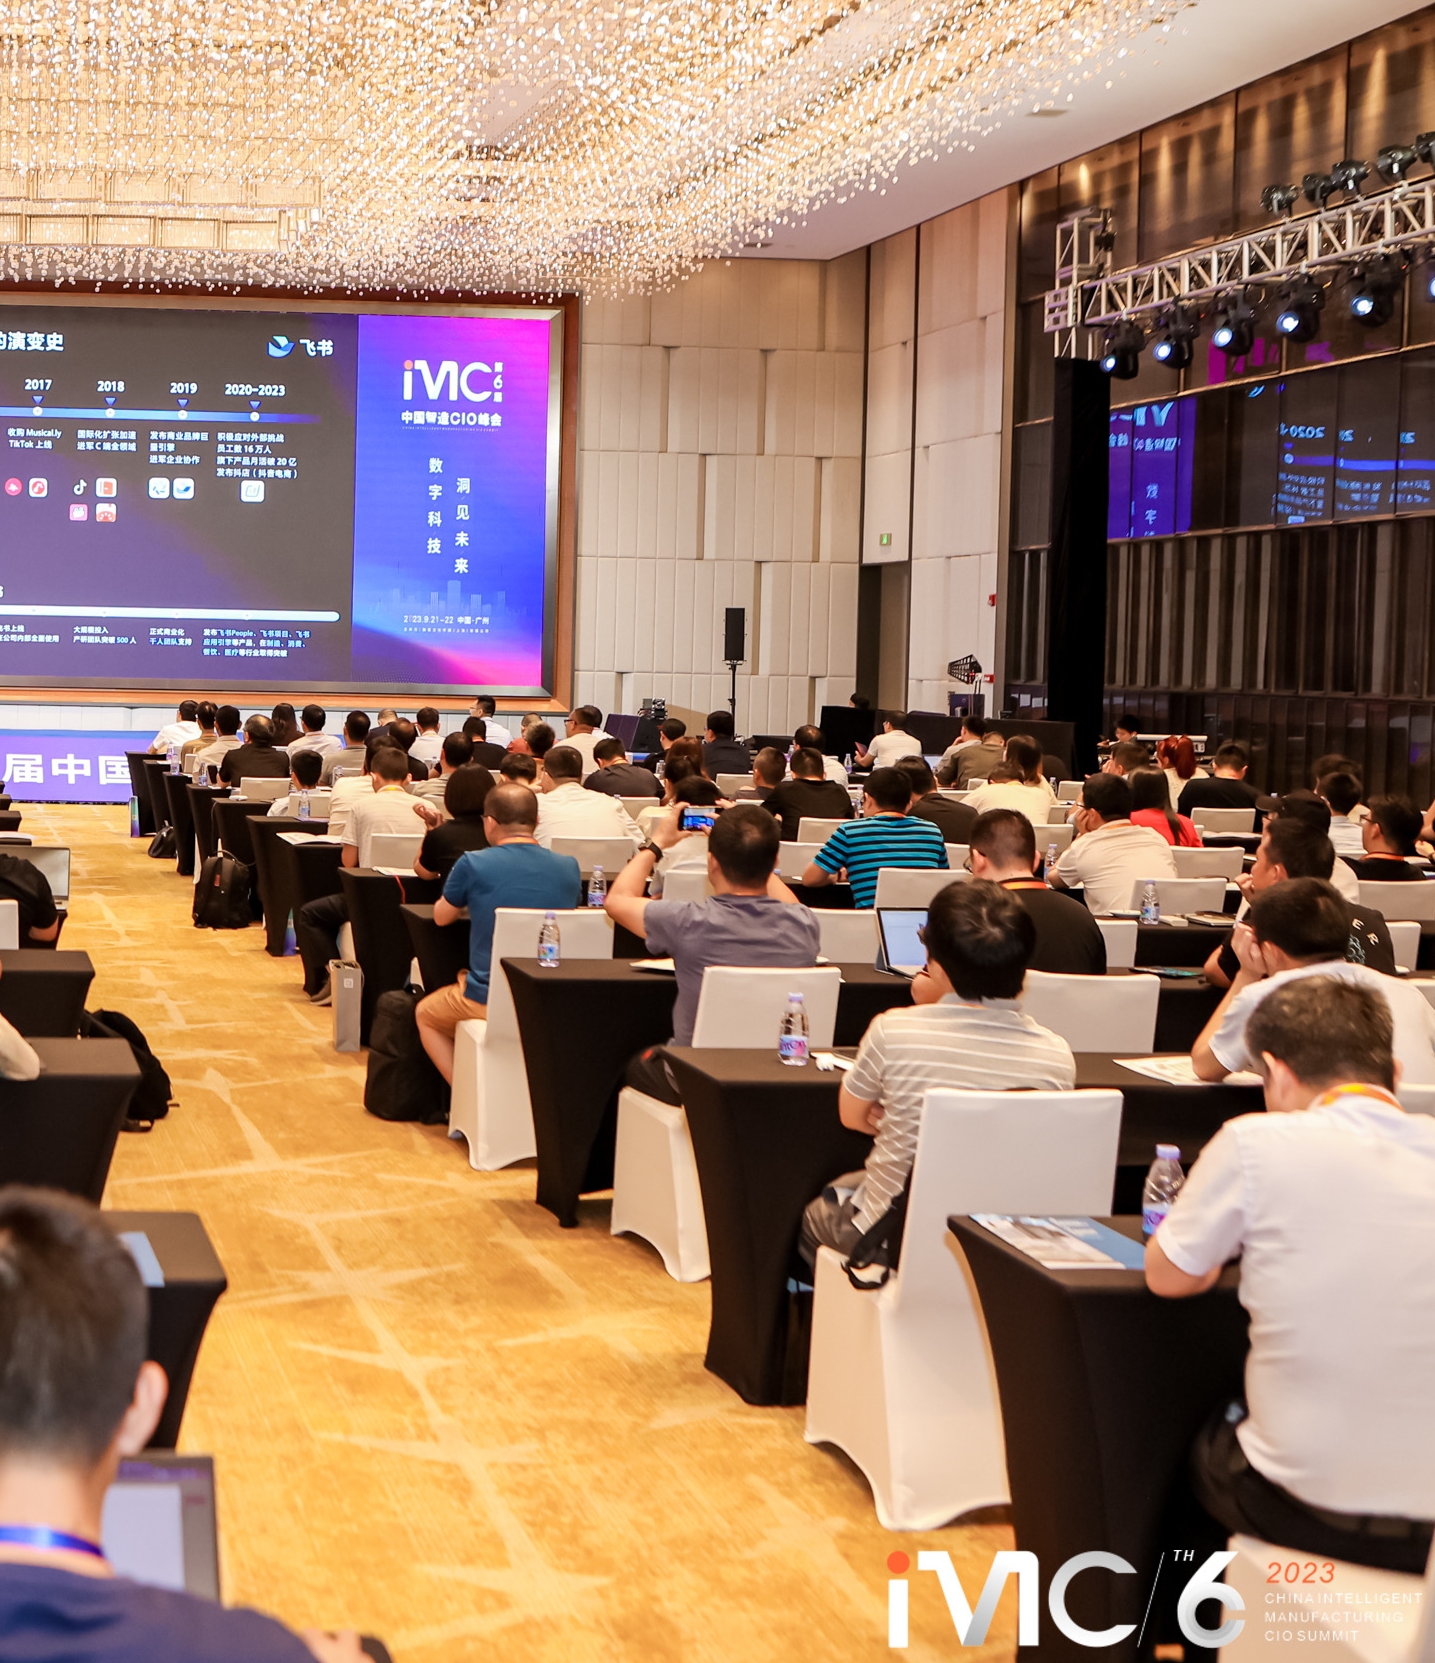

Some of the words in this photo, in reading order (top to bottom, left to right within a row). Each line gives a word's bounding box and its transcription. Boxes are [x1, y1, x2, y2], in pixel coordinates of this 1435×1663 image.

[299, 339, 334, 357] 飞书
[24, 378, 53, 390] 2017
[97, 380, 125, 392] 2018
[169, 382, 198, 394] 2019
[401, 410, 502, 427] 中国智造CIO峰会
[7, 427, 24, 437] 收购
[77, 429, 137, 440] 国际化扩张加速
[149, 430, 209, 441] 发布商业品牌巨
[217, 432, 285, 443] 积极应对外部挑战
[9, 440, 33, 449] TikTok
[35, 439, 53, 450] 上线
[149, 442, 176, 452] 量引擎
[149, 455, 200, 464] 进军企业协作
[427, 457, 443, 554] 数字科技
[454, 477, 470, 574] 洞见未来
